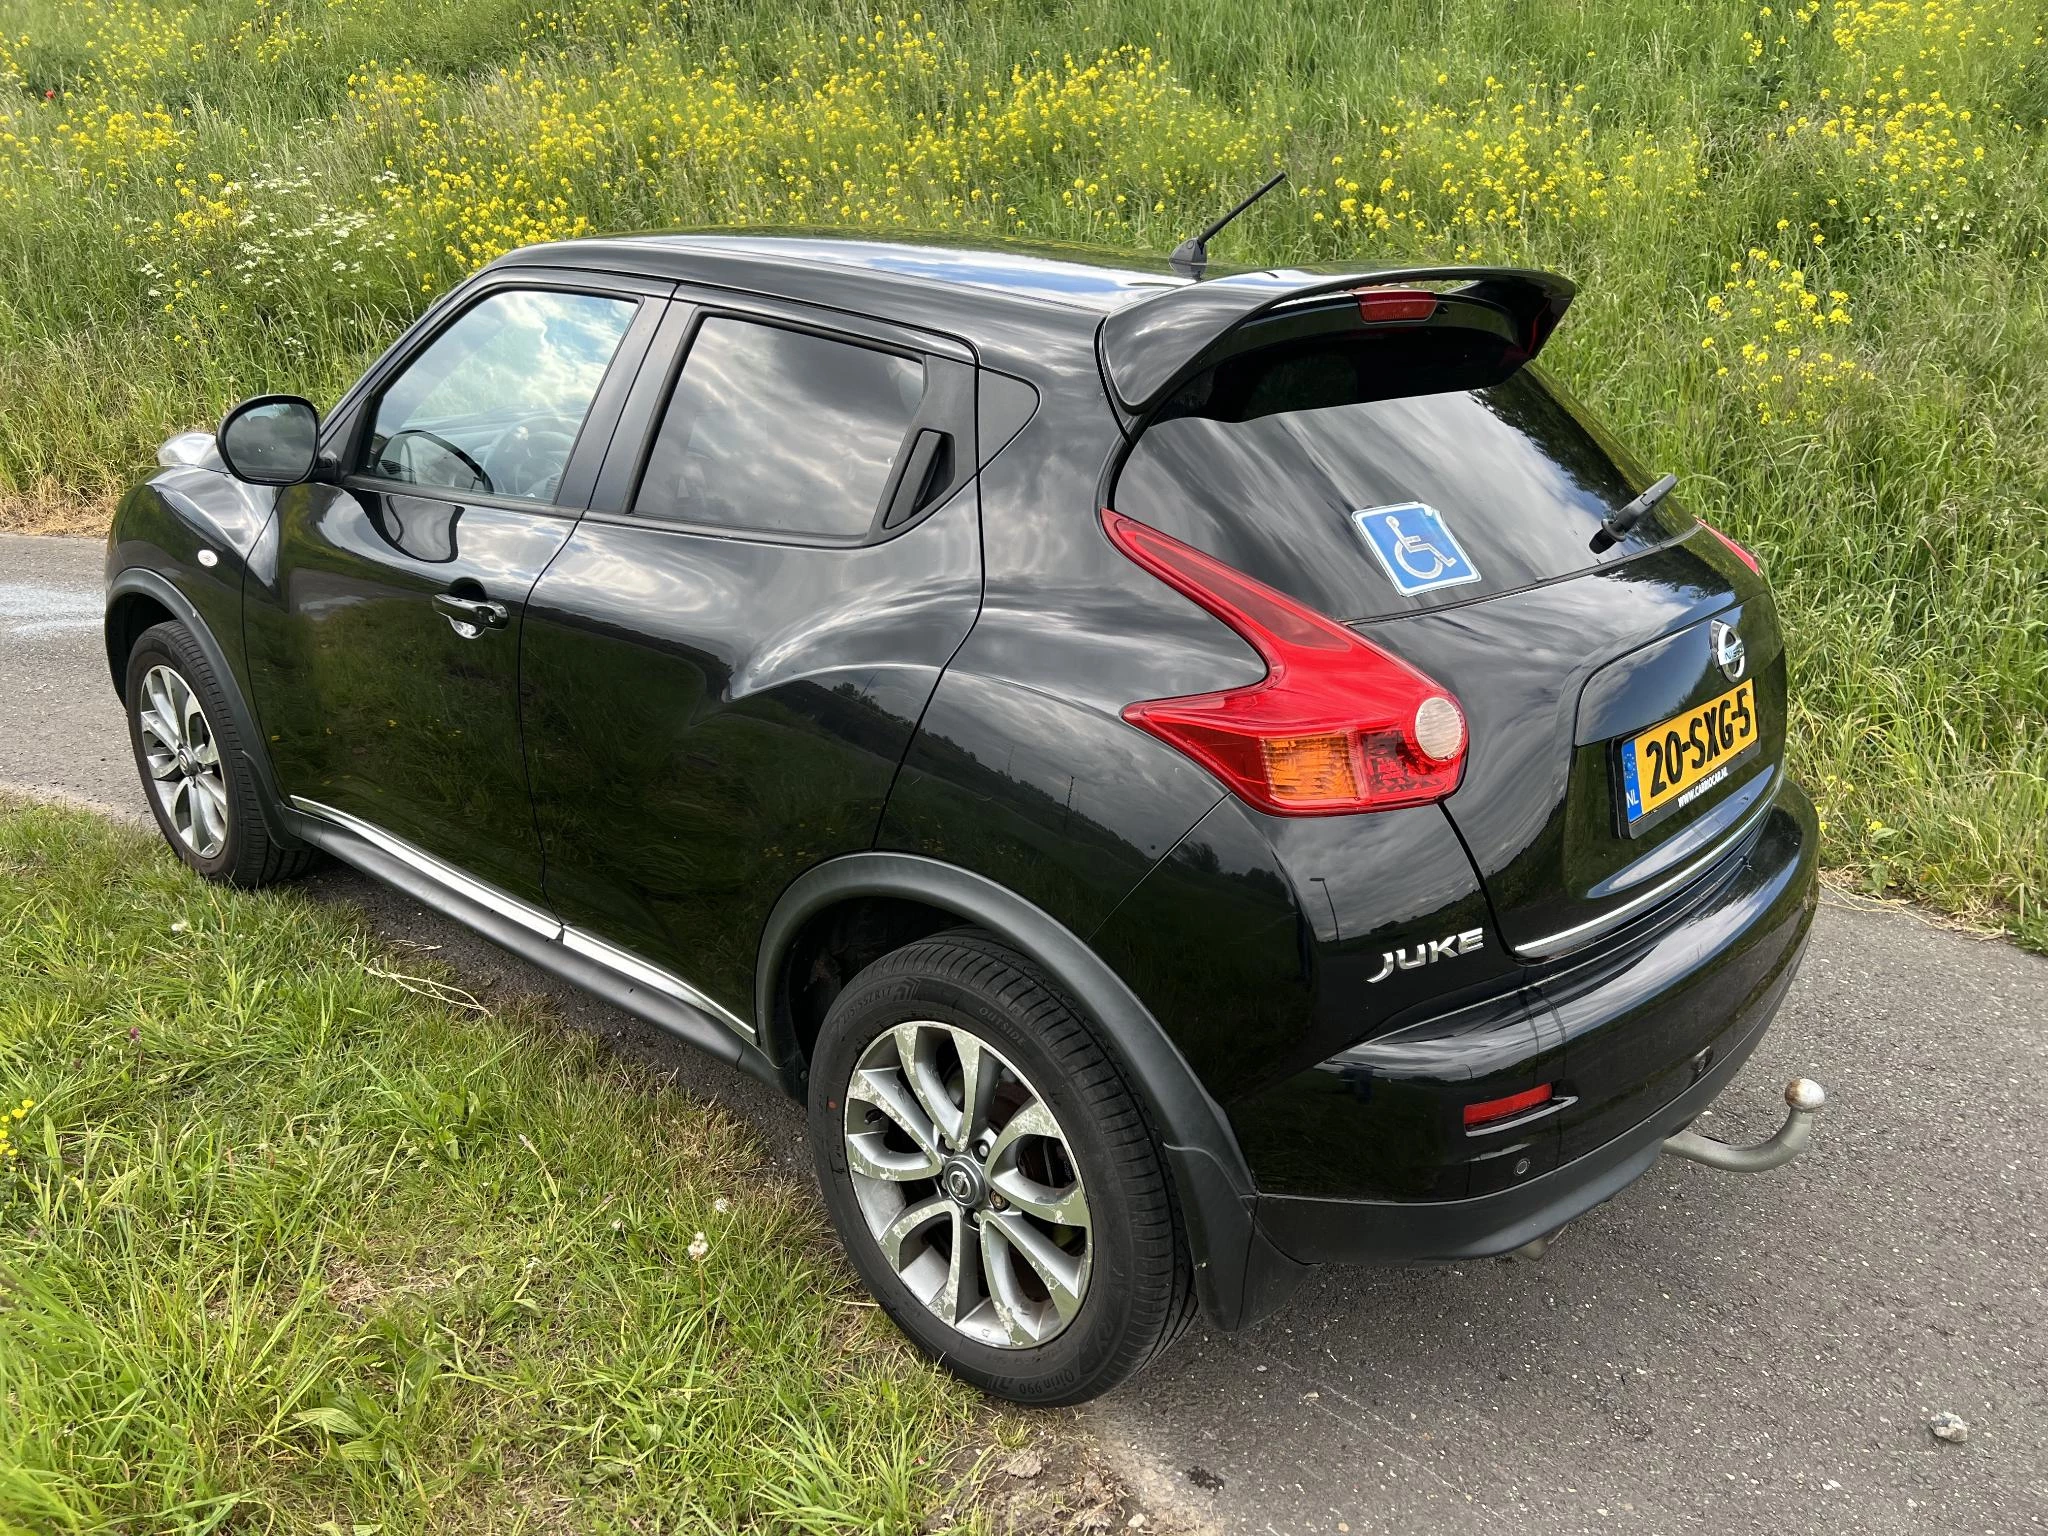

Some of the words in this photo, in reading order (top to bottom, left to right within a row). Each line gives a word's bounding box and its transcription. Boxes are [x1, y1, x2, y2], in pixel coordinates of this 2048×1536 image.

[1646, 687, 1751, 798] 20-SXG-5
[1625, 788, 1640, 809] NL
[1366, 927, 1485, 984] JUKE
